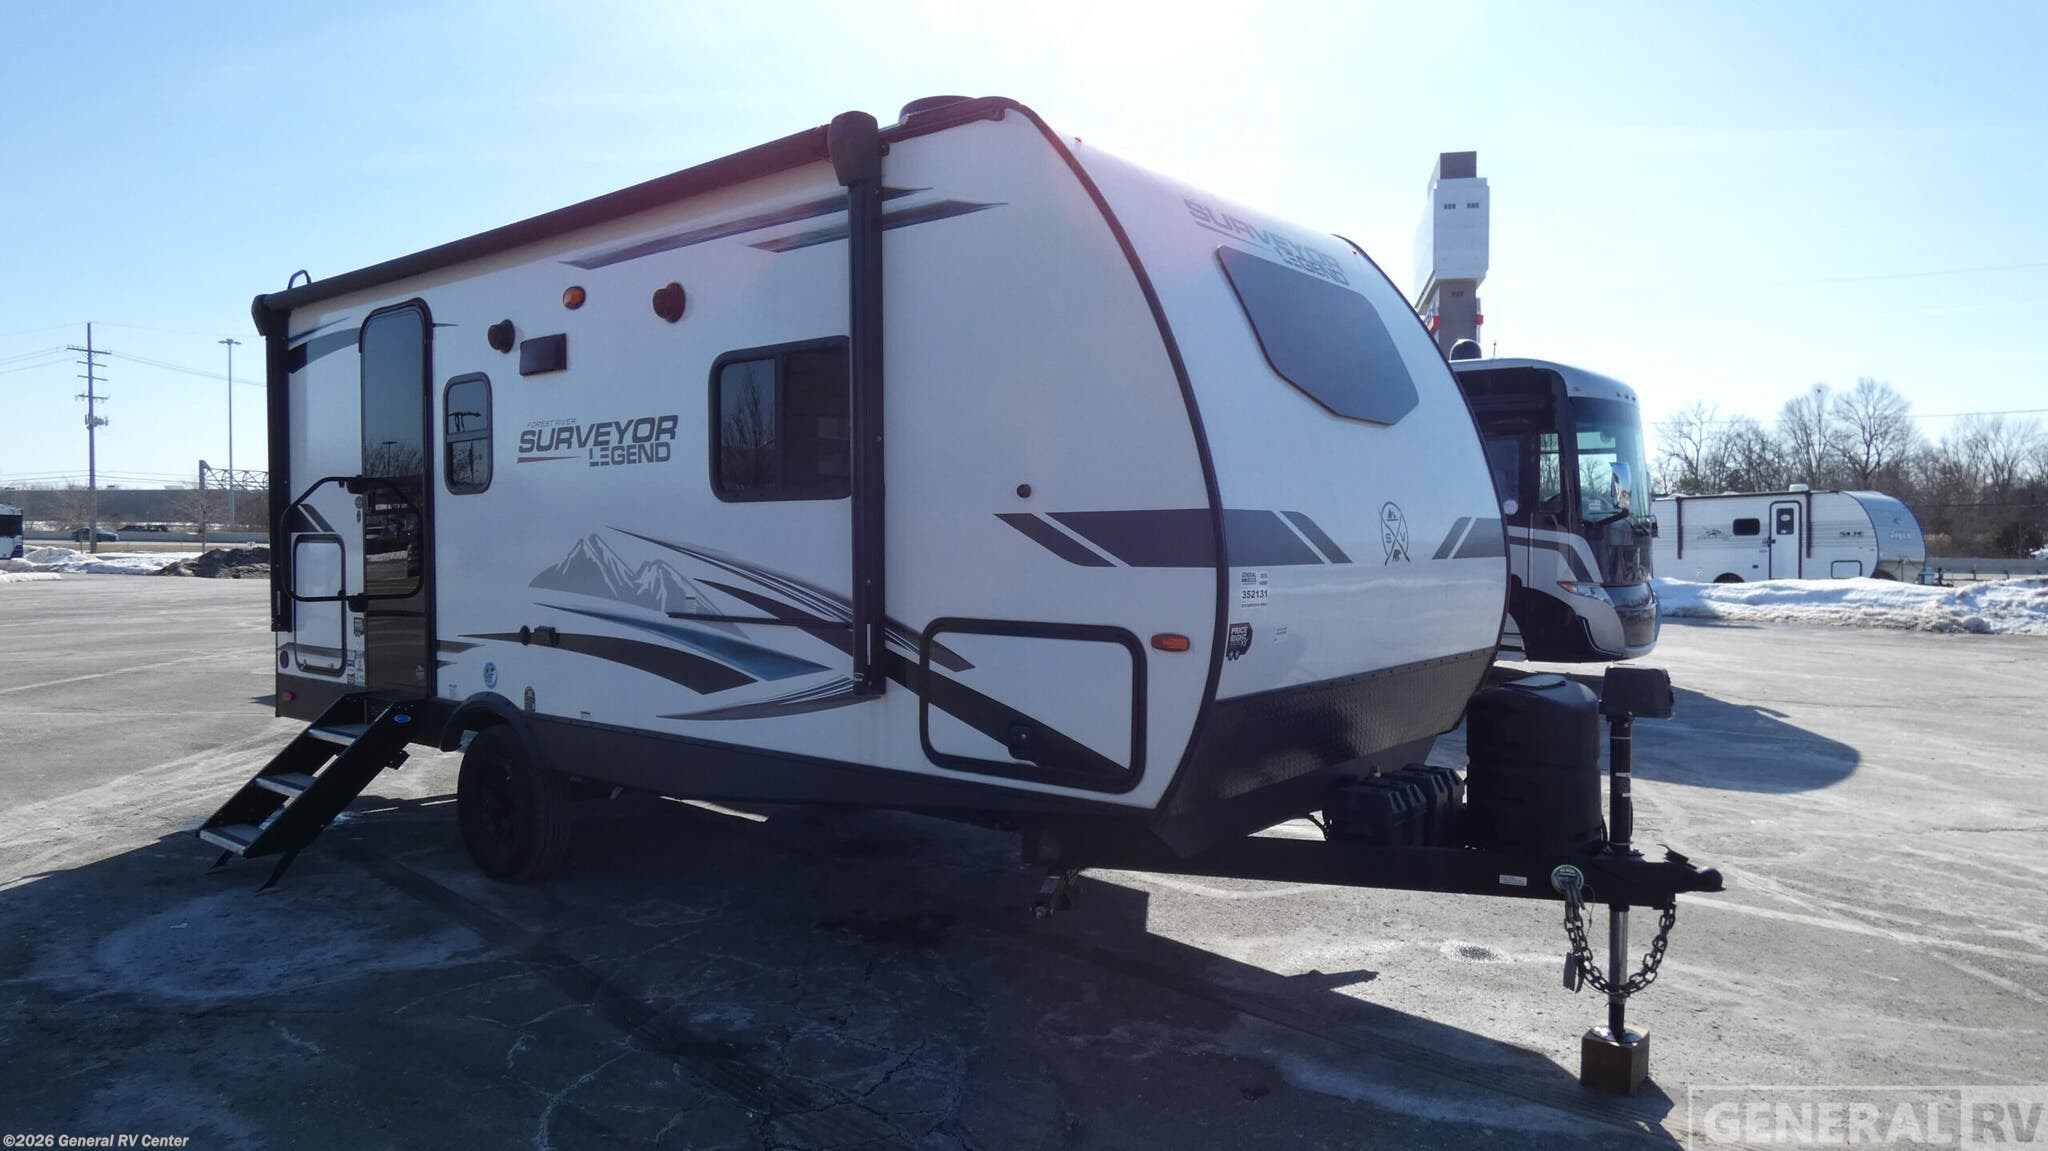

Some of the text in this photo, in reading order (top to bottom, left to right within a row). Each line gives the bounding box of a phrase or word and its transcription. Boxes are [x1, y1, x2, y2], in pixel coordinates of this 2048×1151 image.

[1184, 198, 1345, 274] SURVEYOR
[518, 414, 679, 454] SURVEYOR
[527, 419, 554, 429] FOREST
[589, 441, 671, 467] LEGEND
[1241, 589, 1268, 599] 352131
